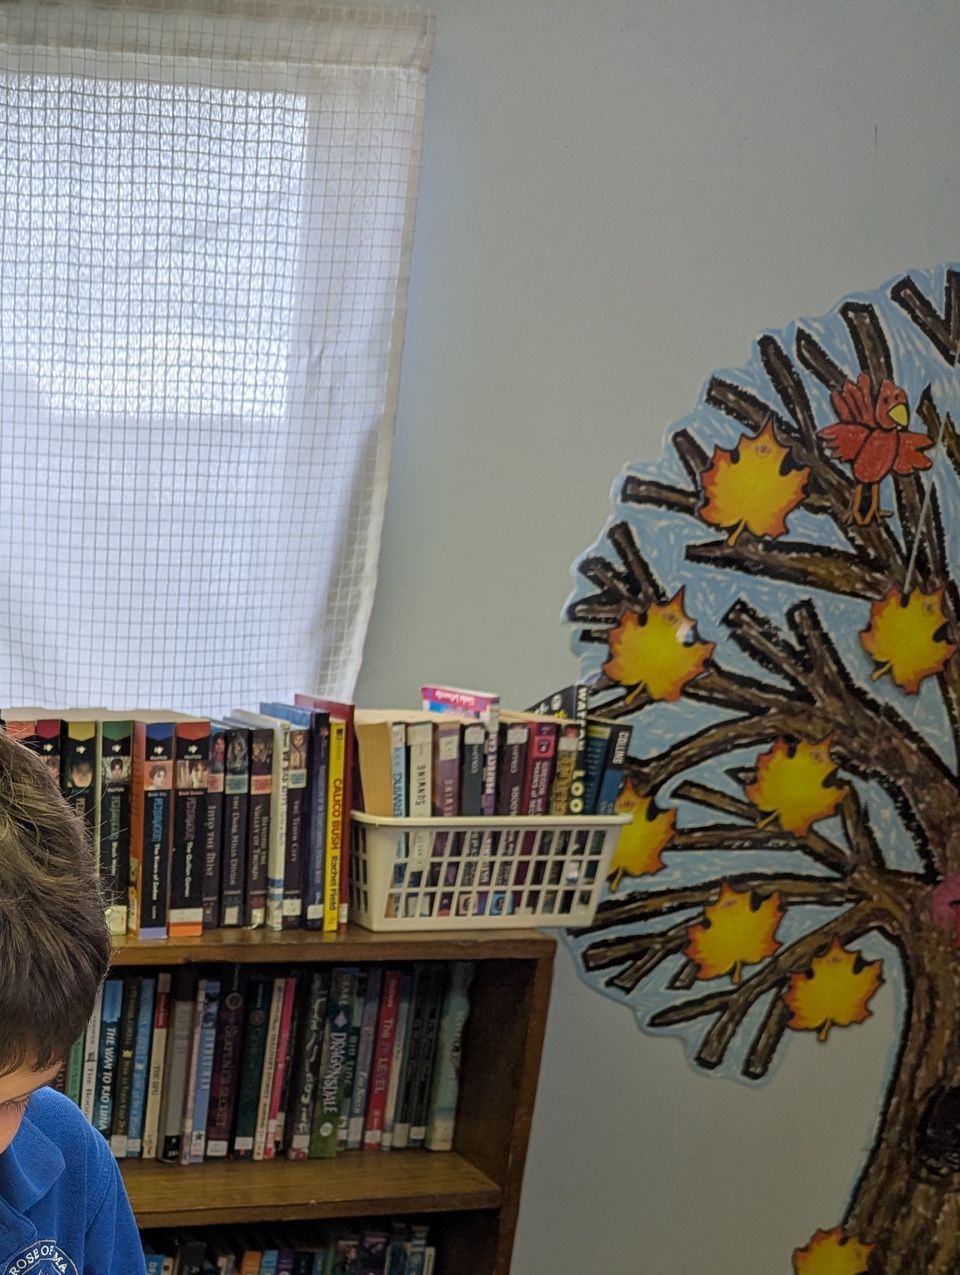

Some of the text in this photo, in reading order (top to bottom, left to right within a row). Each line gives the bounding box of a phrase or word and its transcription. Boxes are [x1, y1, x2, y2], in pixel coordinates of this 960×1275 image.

[612, 732, 629, 765] COLLINS
[329, 778, 342, 910] CALICO BUSH Rachel Field
